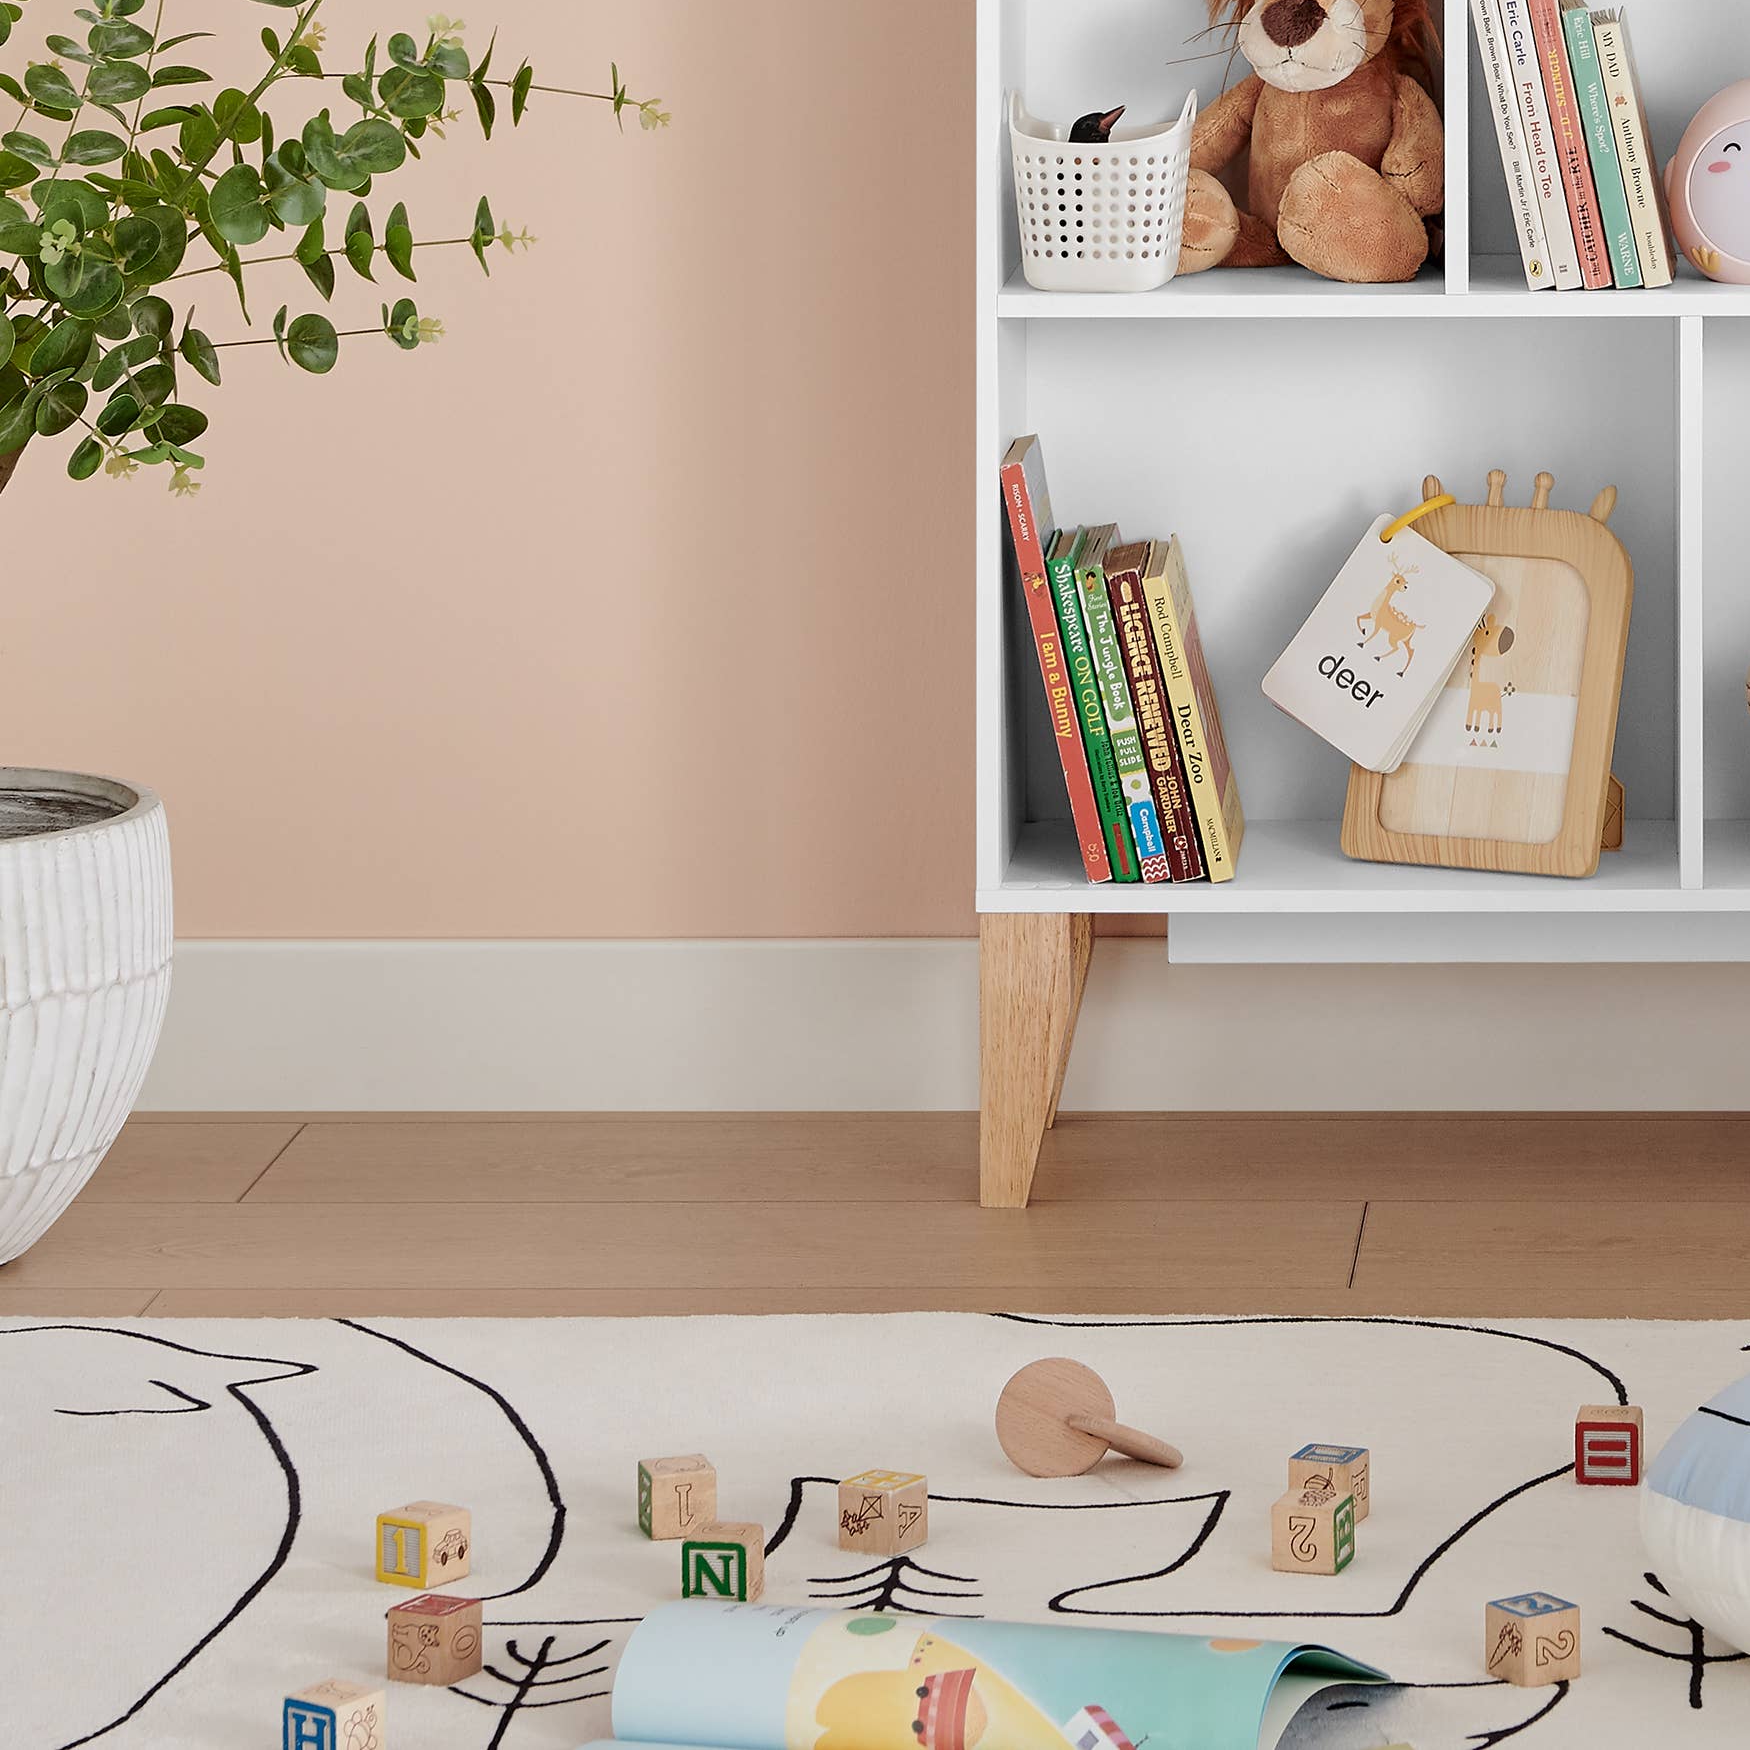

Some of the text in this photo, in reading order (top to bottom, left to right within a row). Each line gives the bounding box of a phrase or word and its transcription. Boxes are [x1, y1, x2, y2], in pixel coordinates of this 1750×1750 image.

[1483, 17, 1491, 37] Bear,
[1506, 1, 1527, 66] Eric Carle
[1573, 16, 1591, 60] Eric Hill
[1487, 37, 1497, 62] Brown
[1602, 30, 1620, 78] MY DAD
[1492, 62, 1500, 82] Bear,
[1548, 49, 1567, 107] SALINGER
[1497, 83, 1506, 103] What
[1500, 103, 1508, 115] Do
[1503, 116, 1511, 131] You
[1587, 82, 1609, 153] Where's Spot?
[1506, 131, 1516, 150] See?
[1522, 82, 1552, 199] From Head to Toe
[1566, 146, 1581, 175] RYE
[1621, 117, 1646, 209] Anthony Browne
[1515, 174, 1524, 198] Martin
[1523, 212, 1531, 227] Eric
[1526, 228, 1535, 248] Carle
[1576, 201, 1598, 262] CATCHER
[1618, 231, 1635, 276] WARNE
[1645, 231, 1657, 270] Doubleday
[1012, 483, 1030, 541] RISOM SCARRY
[1055, 564, 1084, 653] Shakespeare
[1042, 642, 1058, 668] am
[1154, 596, 1183, 680] Rod Campbell
[1049, 674, 1061, 684] a
[1075, 656, 1093, 685] ON
[1096, 611, 1126, 711] The Jungle Book
[1317, 655, 1384, 708] deer
[1120, 602, 1172, 772] LICENCE RENEWED
[1052, 686, 1073, 739] Bunny
[1082, 688, 1105, 736] GOLF
[1116, 735, 1137, 747] PUSH
[1119, 746, 1137, 756] PULL
[1119, 755, 1142, 767] SLIDE
[1177, 704, 1203, 784] Dear Zoo
[1156, 776, 1176, 834] GARDNER
[1166, 775, 1182, 810] JOHN
[1140, 808, 1157, 853] Campbell
[1207, 818, 1222, 857] MACMILLAN
[898, 1502, 923, 1539] A
[1289, 1515, 1317, 1563] 2
[392, 1527, 409, 1575] 1
[690, 1553, 736, 1597] N
[1536, 1630, 1575, 1667] 2
[291, 1712, 327, 1750] H
